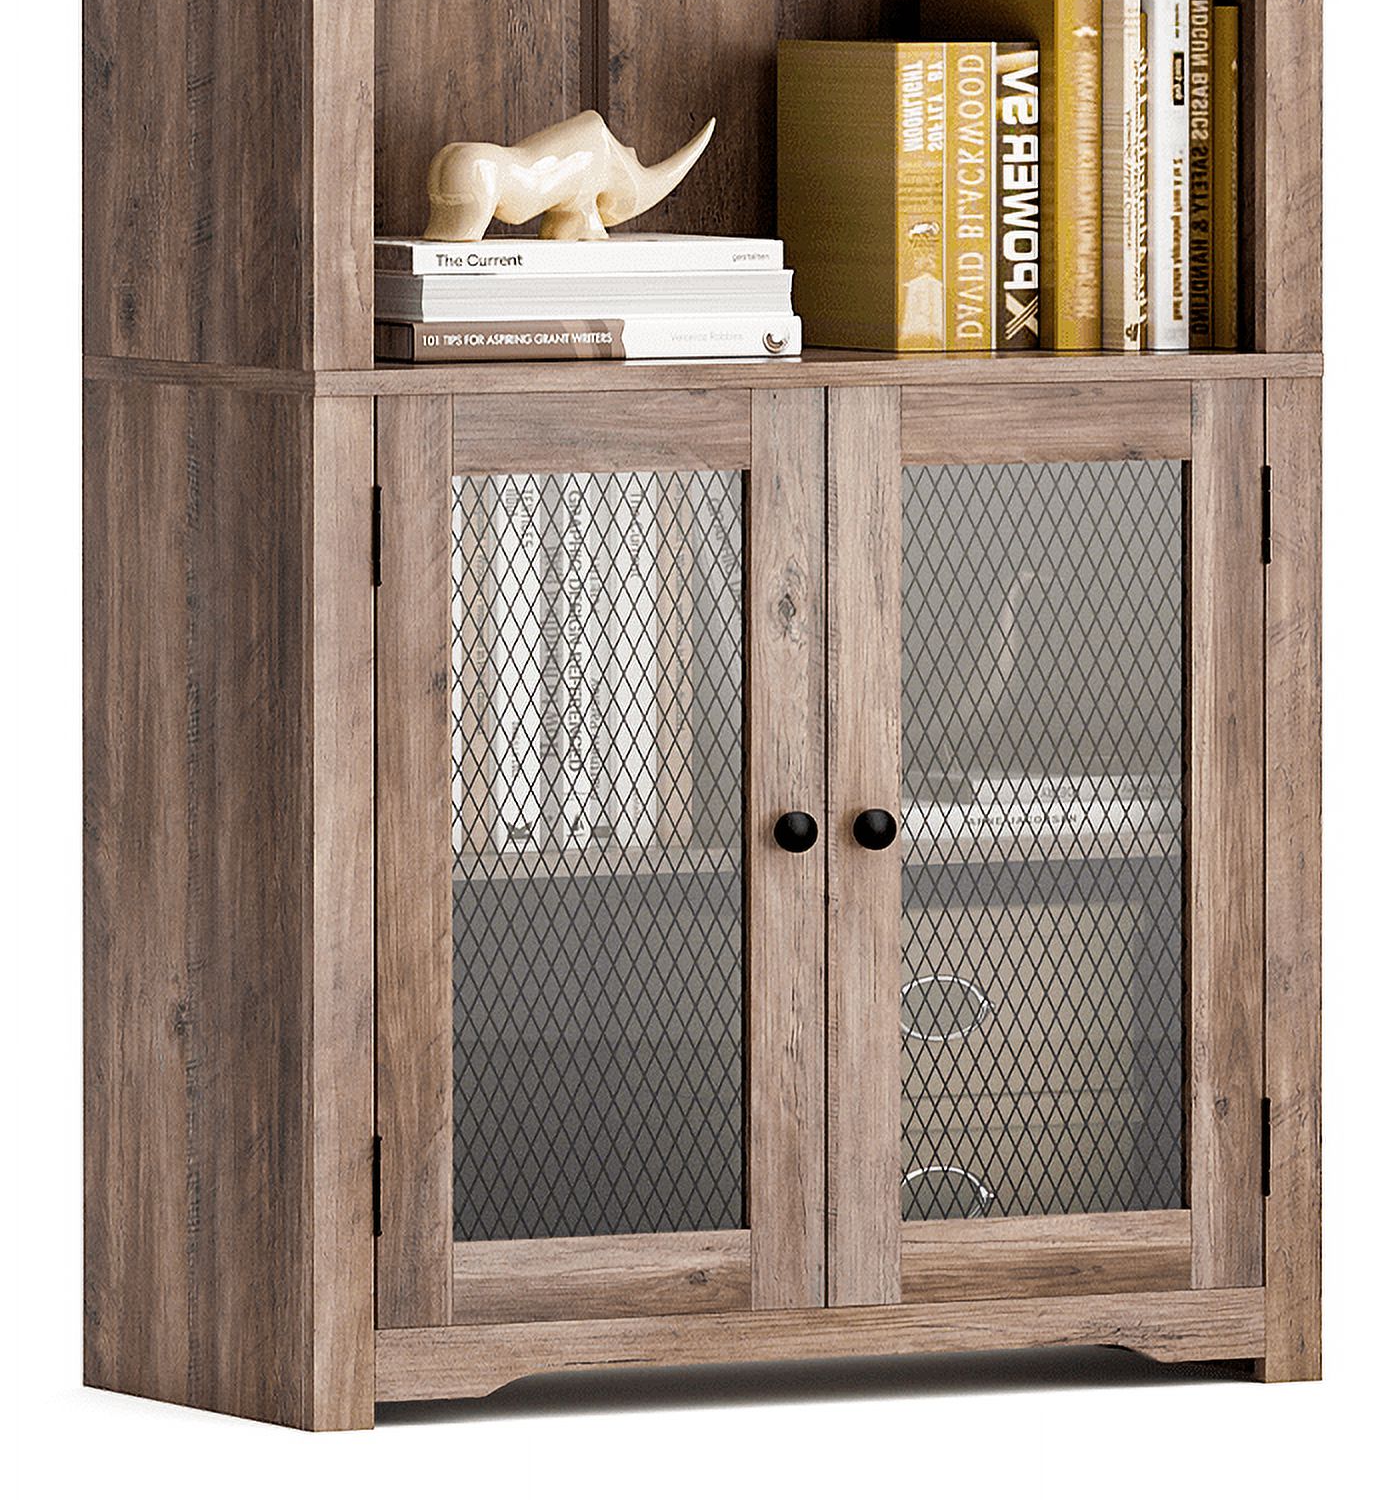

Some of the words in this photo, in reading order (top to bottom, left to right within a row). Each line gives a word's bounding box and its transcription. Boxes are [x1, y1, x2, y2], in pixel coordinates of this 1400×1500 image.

[436, 253, 463, 267] The
[466, 253, 524, 267] Current
[423, 335, 440, 347] 101
[443, 334, 463, 346] TIPS
[464, 334, 486, 346] FOR
[486, 334, 532, 346] ASPIRING
[533, 332, 571, 345] GRANT
[571, 331, 613, 345] WRITERS
